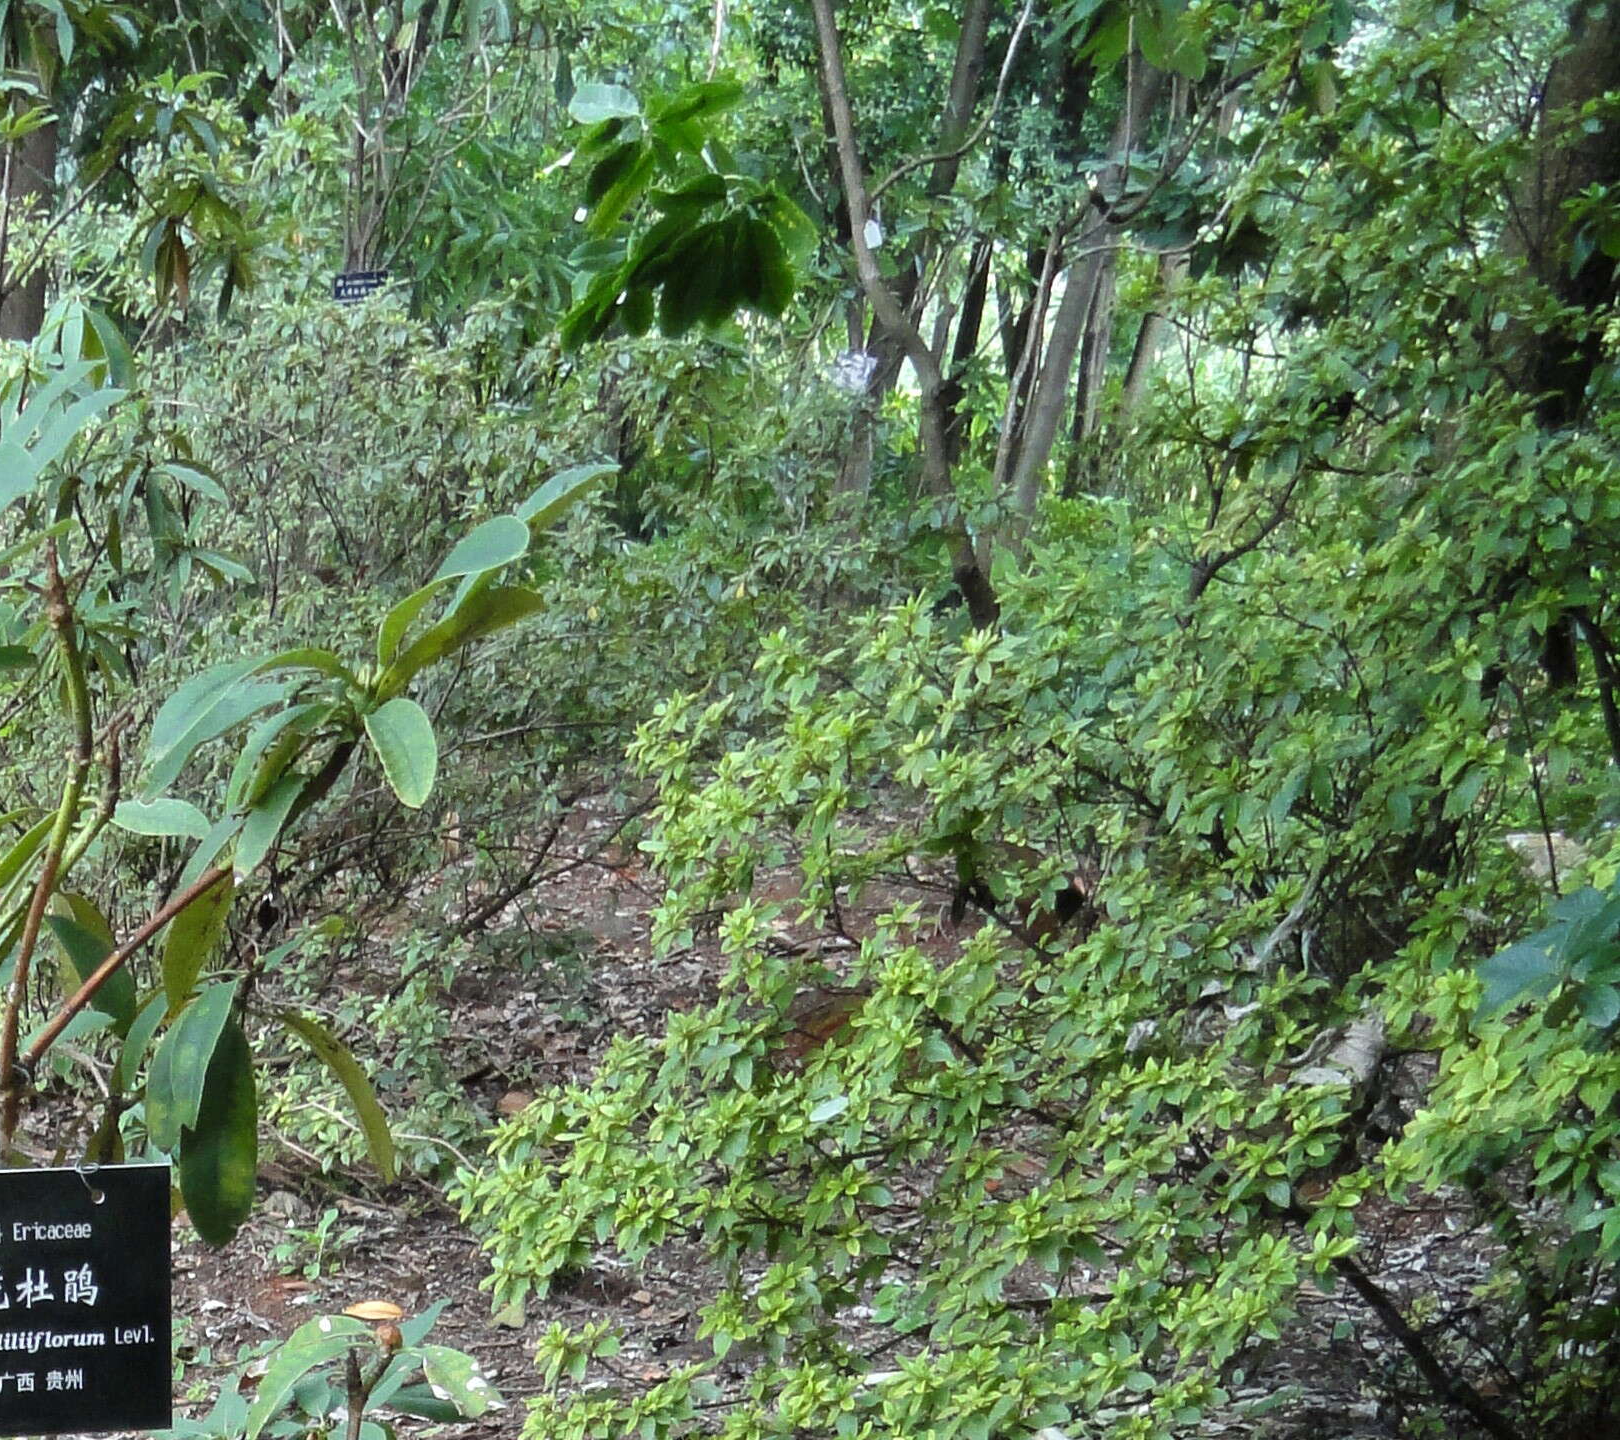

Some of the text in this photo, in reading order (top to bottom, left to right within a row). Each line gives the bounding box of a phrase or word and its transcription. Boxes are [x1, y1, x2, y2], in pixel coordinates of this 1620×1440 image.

[12, 1221, 92, 1242] Ericaceae
[114, 1324, 155, 1345] Levl.
[45, 1368, 83, 1391] 贵州
